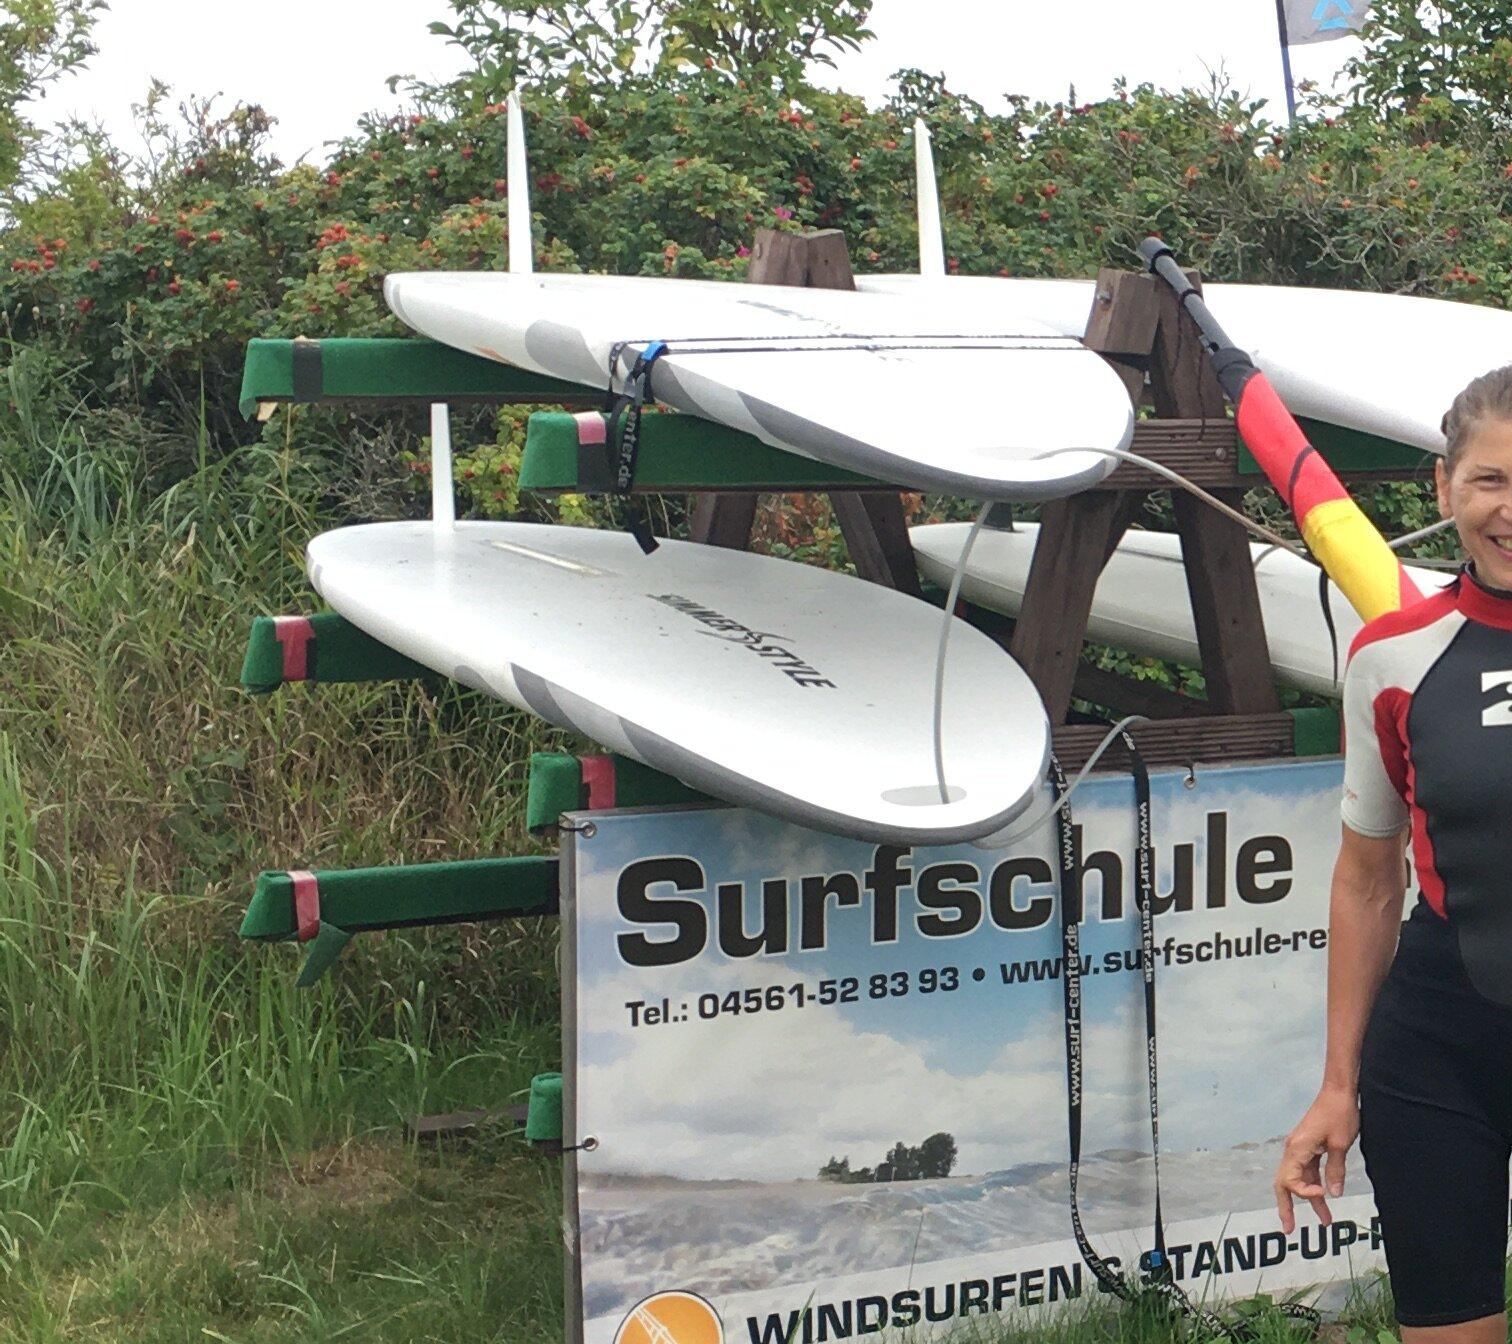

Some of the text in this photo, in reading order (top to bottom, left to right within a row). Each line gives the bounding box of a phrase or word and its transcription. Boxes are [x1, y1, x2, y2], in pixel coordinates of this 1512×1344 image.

[615, 810, 1294, 969] Surfschule
[624, 998, 689, 1028] Tel.:
[697, 976, 860, 1020] 04561-52
[868, 970, 910, 1000] 83
[917, 965, 960, 994] 93
[1064, 923, 1081, 1107] www.surf-center.de
